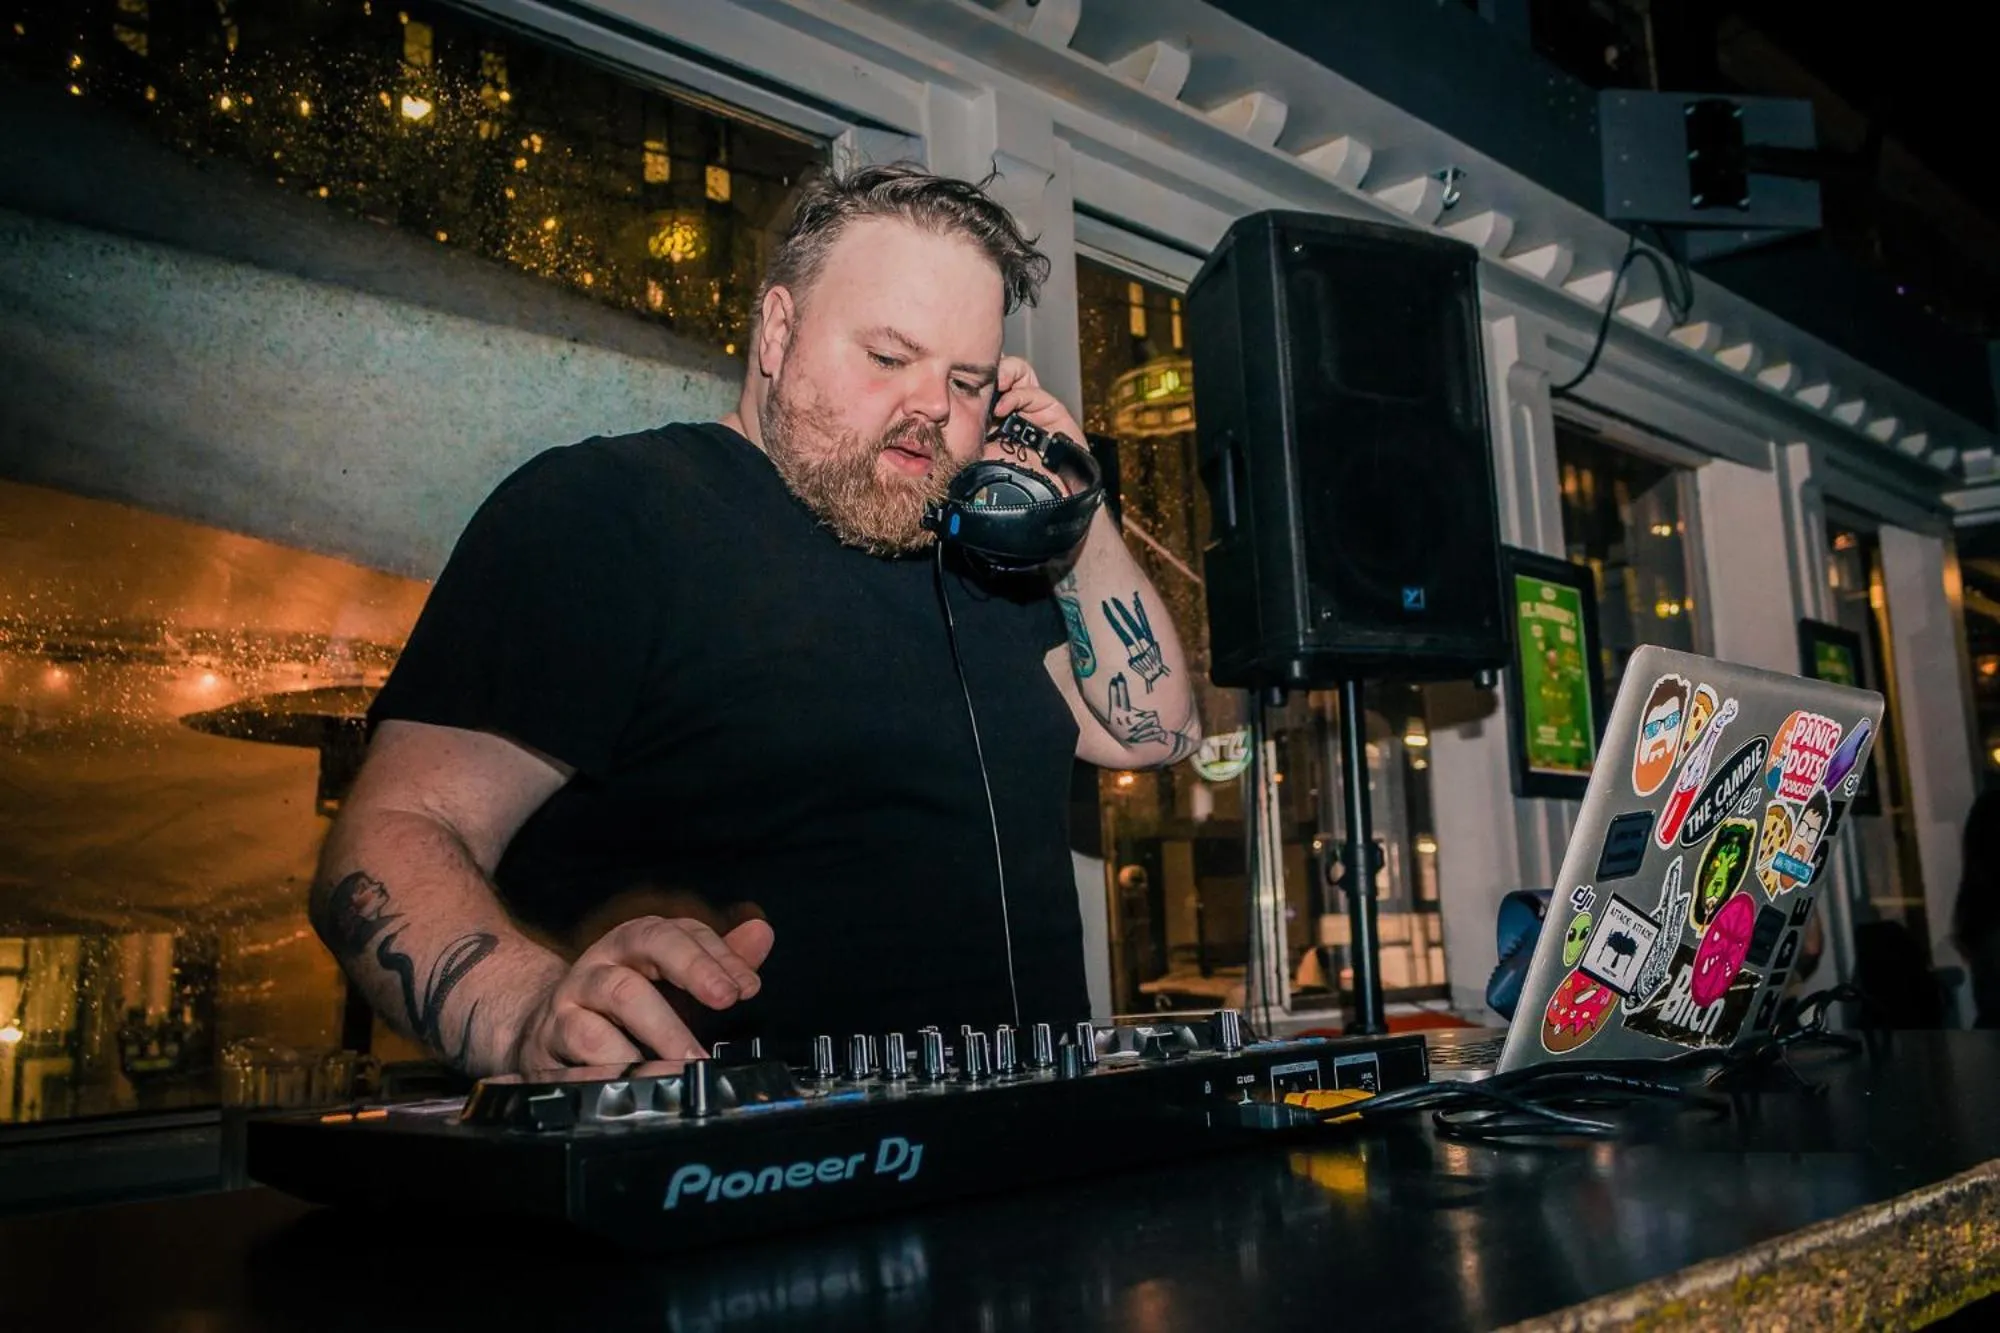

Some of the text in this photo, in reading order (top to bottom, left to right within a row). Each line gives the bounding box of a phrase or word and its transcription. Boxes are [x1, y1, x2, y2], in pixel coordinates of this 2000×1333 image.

[1793, 716, 1840, 755] PANIC
[1785, 748, 1825, 781] DOTS
[1686, 742, 1763, 838] THE CAMBIE
[1780, 778, 1812, 797] PODCAST
[663, 1152, 866, 1211] Pioneer
